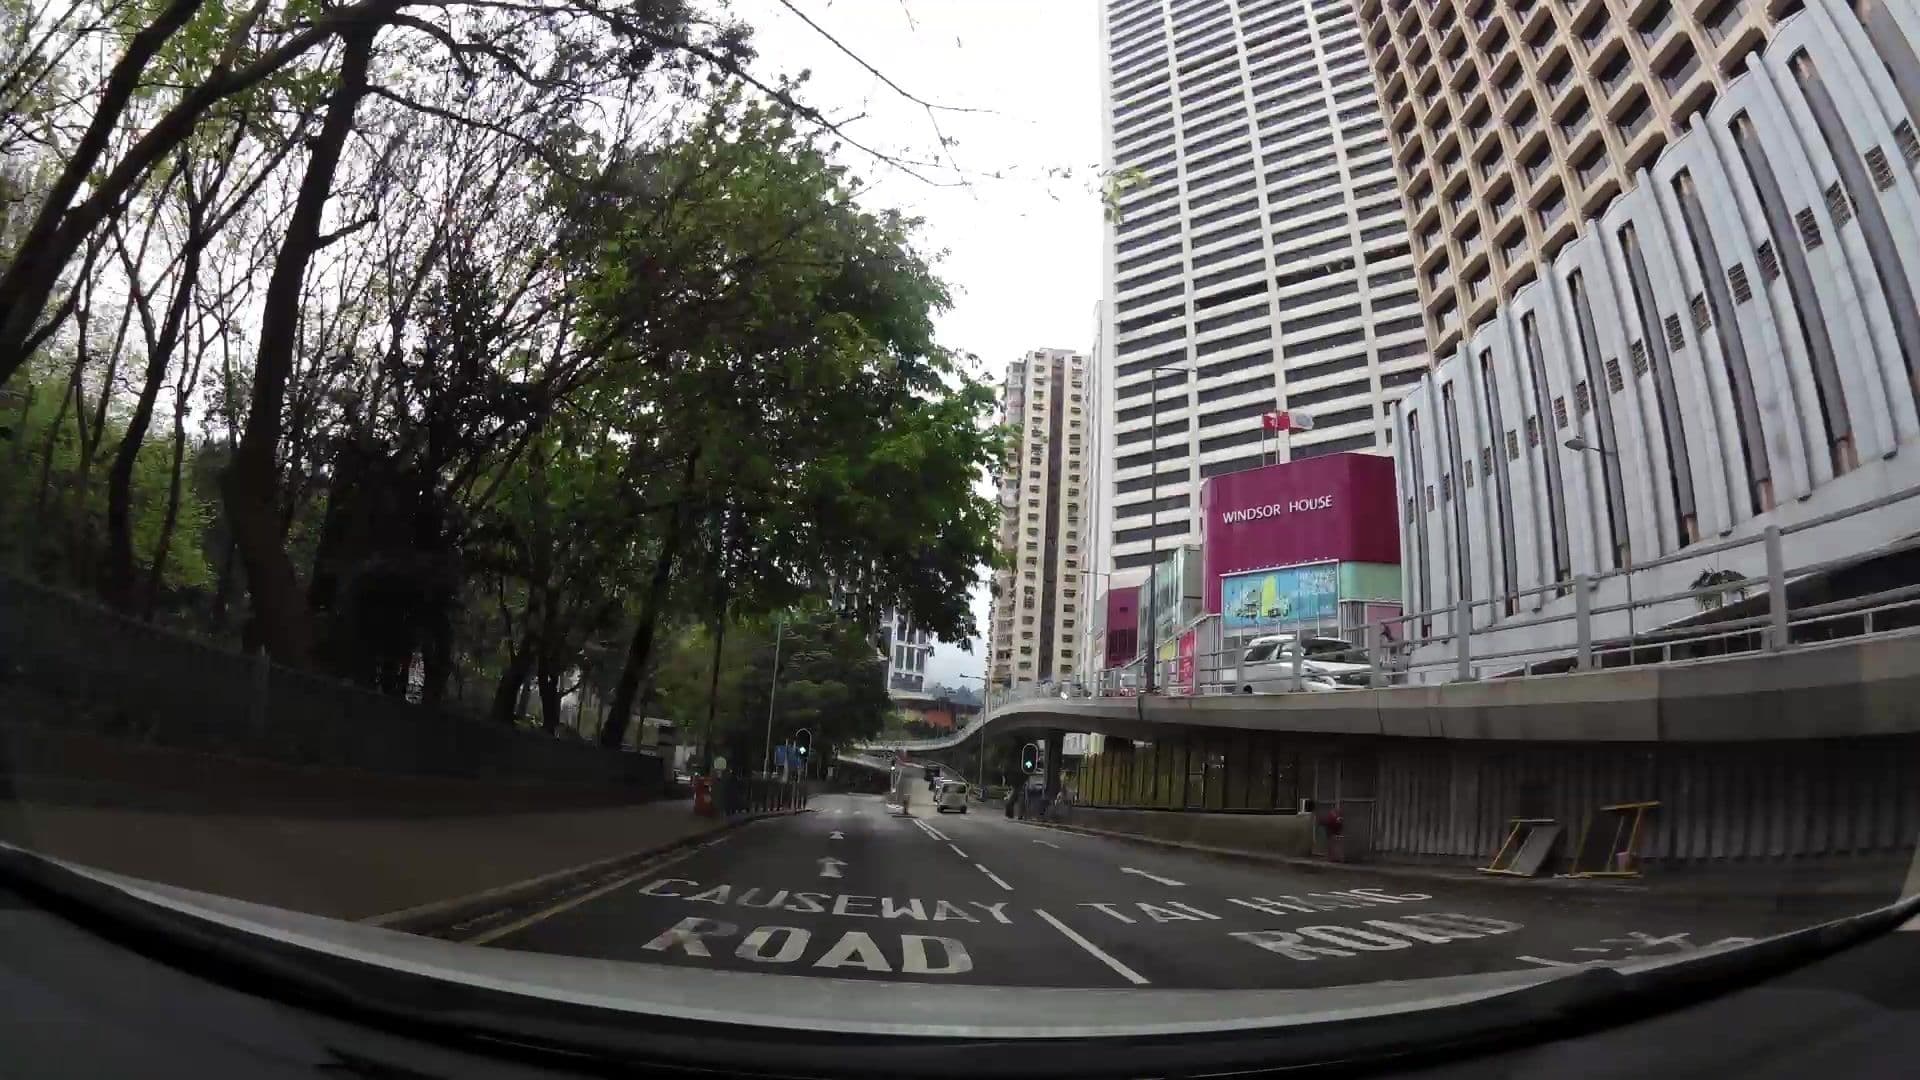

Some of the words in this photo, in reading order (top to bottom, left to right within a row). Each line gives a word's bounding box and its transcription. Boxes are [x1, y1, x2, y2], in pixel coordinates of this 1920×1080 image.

[1223, 504, 1281, 524] WINDSOR
[1289, 494, 1333, 513] HOUSE
[638, 878, 1013, 924] CAUSEWAY
[1078, 901, 1223, 924] TAI
[641, 916, 974, 975] ROAD
[1228, 912, 1525, 961] ROAD
